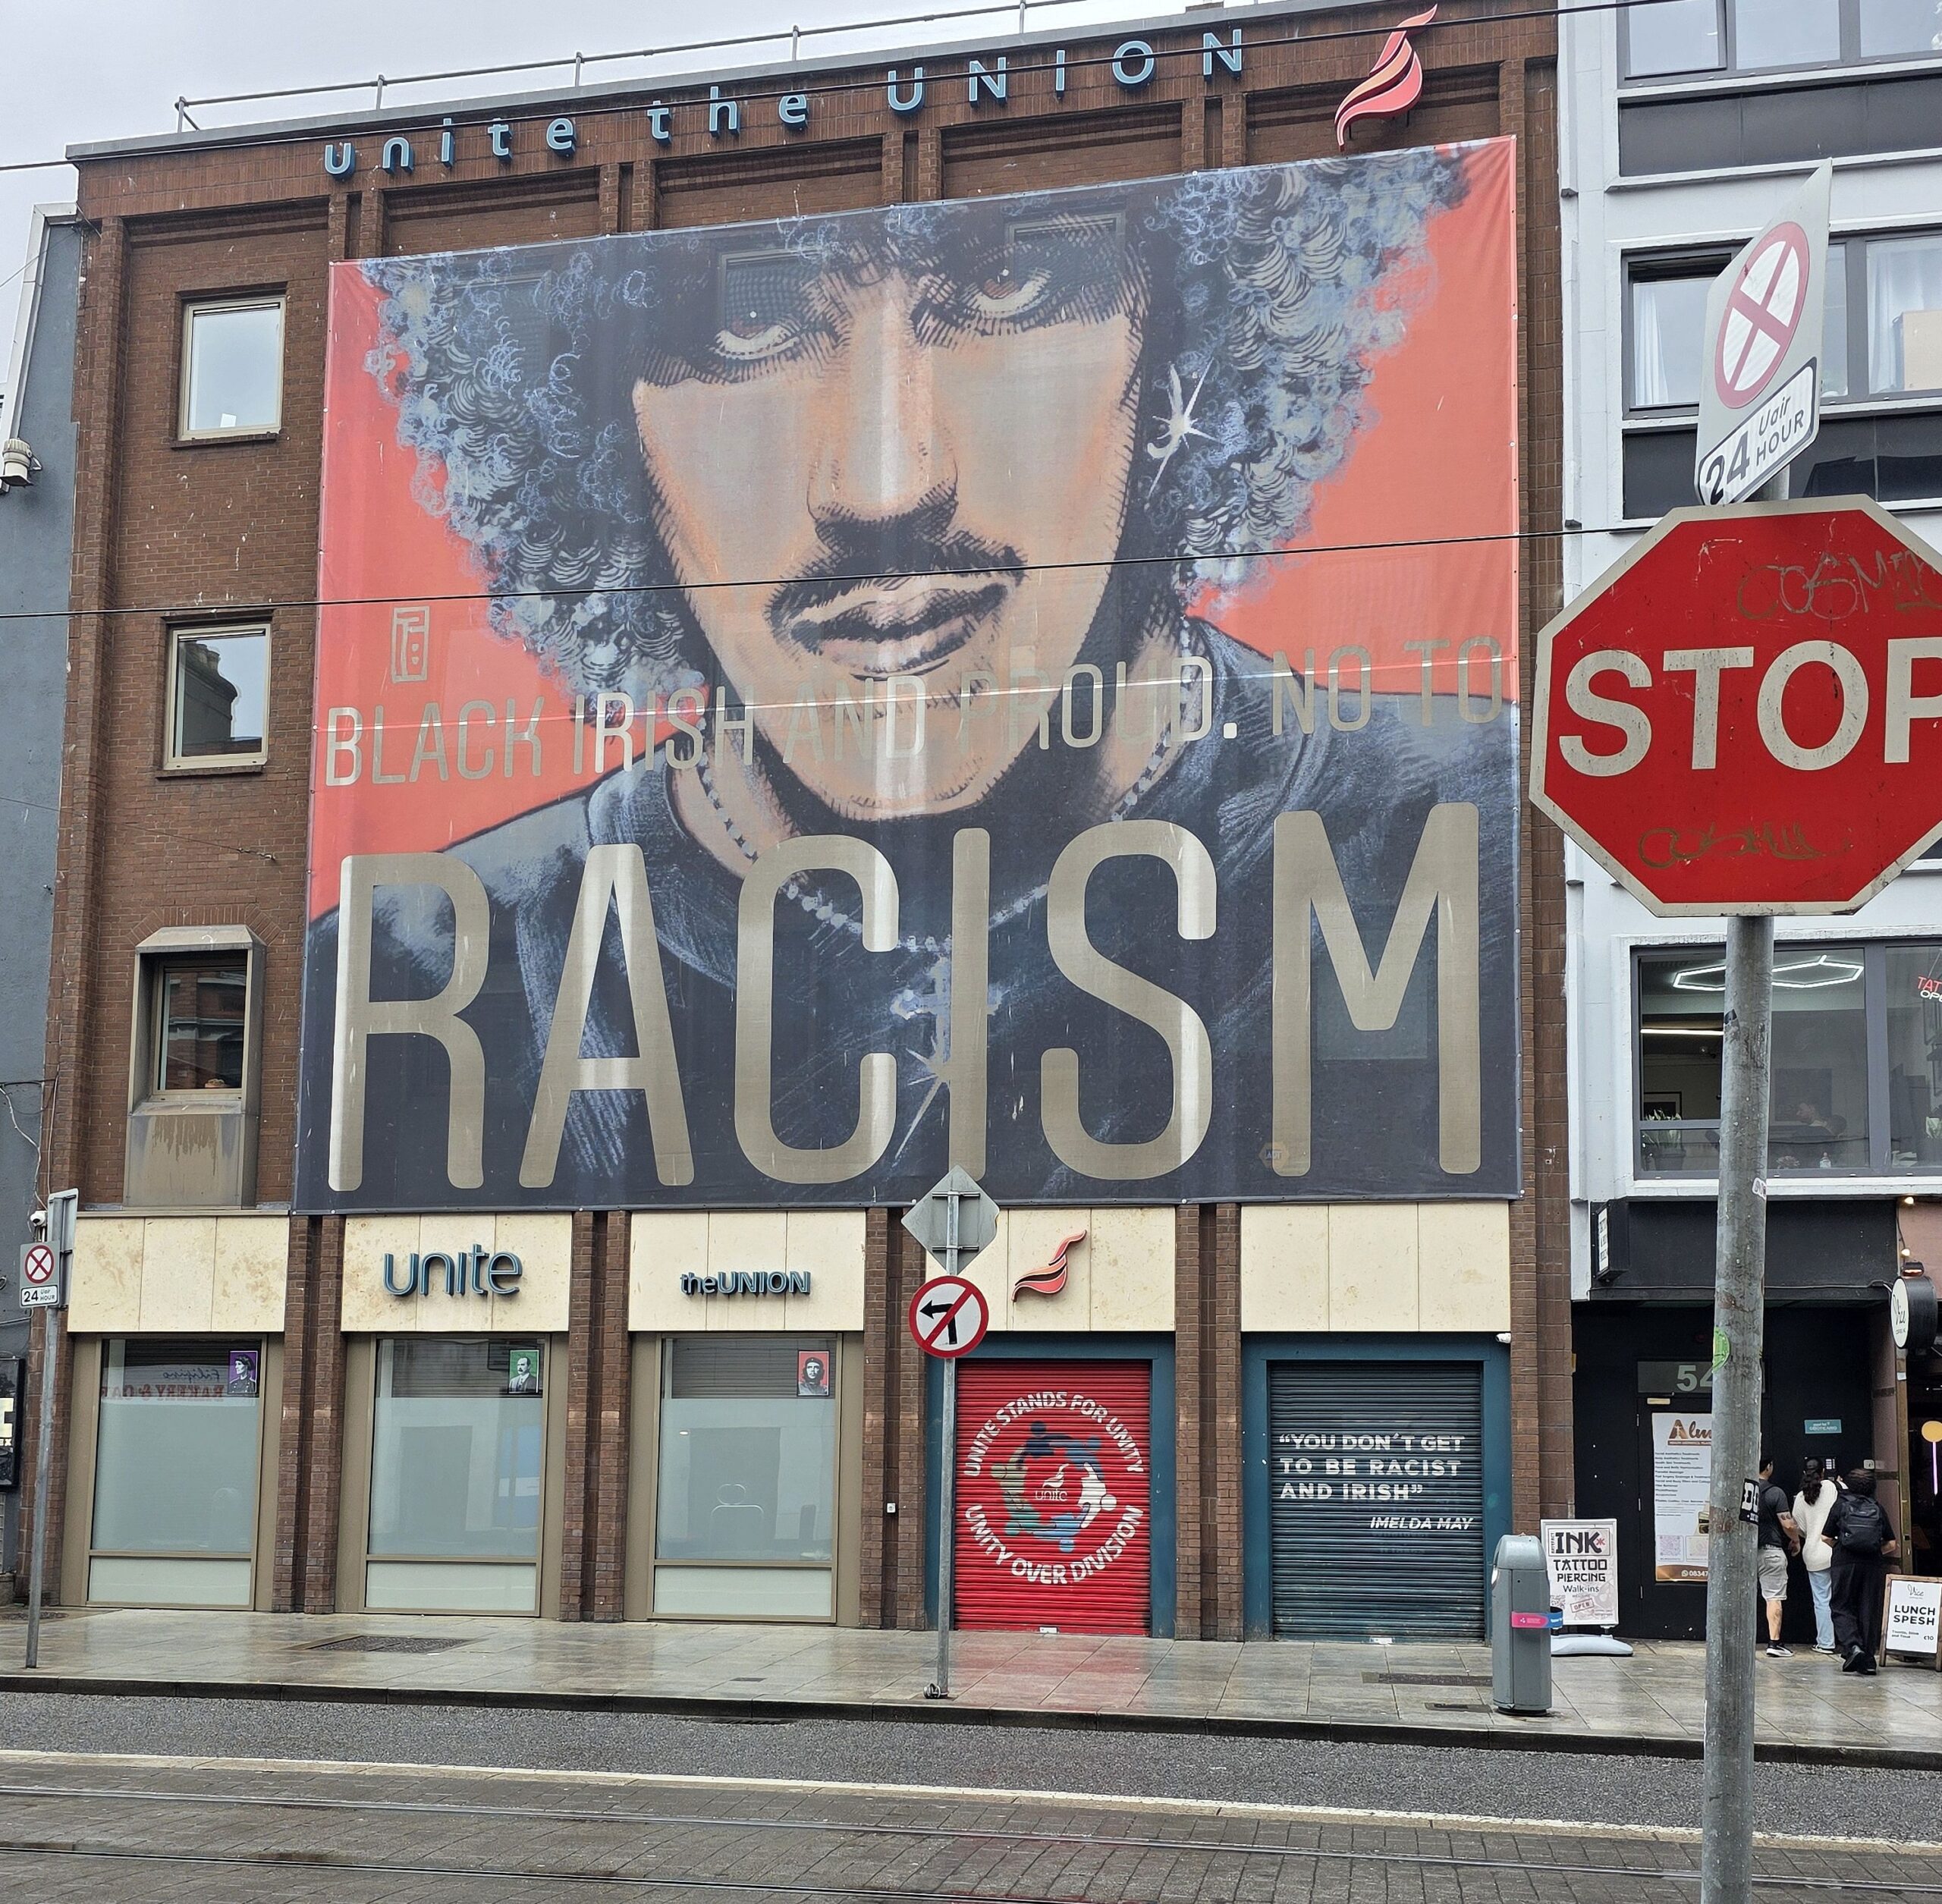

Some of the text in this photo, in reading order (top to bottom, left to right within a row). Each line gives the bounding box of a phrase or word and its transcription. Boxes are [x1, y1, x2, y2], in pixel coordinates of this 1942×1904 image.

[647, 86, 808, 145] the
[888, 28, 1243, 115] UNION
[1755, 408, 1805, 467] HOUR
[1705, 396, 1791, 505] 24 Uair
[325, 636, 1503, 787] BLACK IRISH AND PROUD. NO TO
[1559, 637, 1942, 777] STOP
[328, 801, 1482, 1192] RACISM
[24, 1290, 39, 1302] 24
[996, 1391, 1068, 1425] STANDS
[1070, 1394, 1108, 1423] FOR
[1105, 1418, 1144, 1473] UNITY
[1421, 1435, 1466, 1451] GET
[1280, 1457, 1462, 1476] TO BE RACIST
[1280, 1482, 1333, 1500] AND
[1370, 1516, 1474, 1530] IMELDA MAY
[965, 1505, 1144, 1585] UNITY OVER DIVISION
[1555, 1532, 1603, 1554] INK
[1553, 1559, 1607, 1571] TATTOO
[1557, 1573, 1606, 1582] PIERCING
[1563, 1585, 1600, 1593] Walk-ins
[1894, 1604, 1936, 1616] LUNCH
[1893, 1614, 1934, 1626] SPESH
